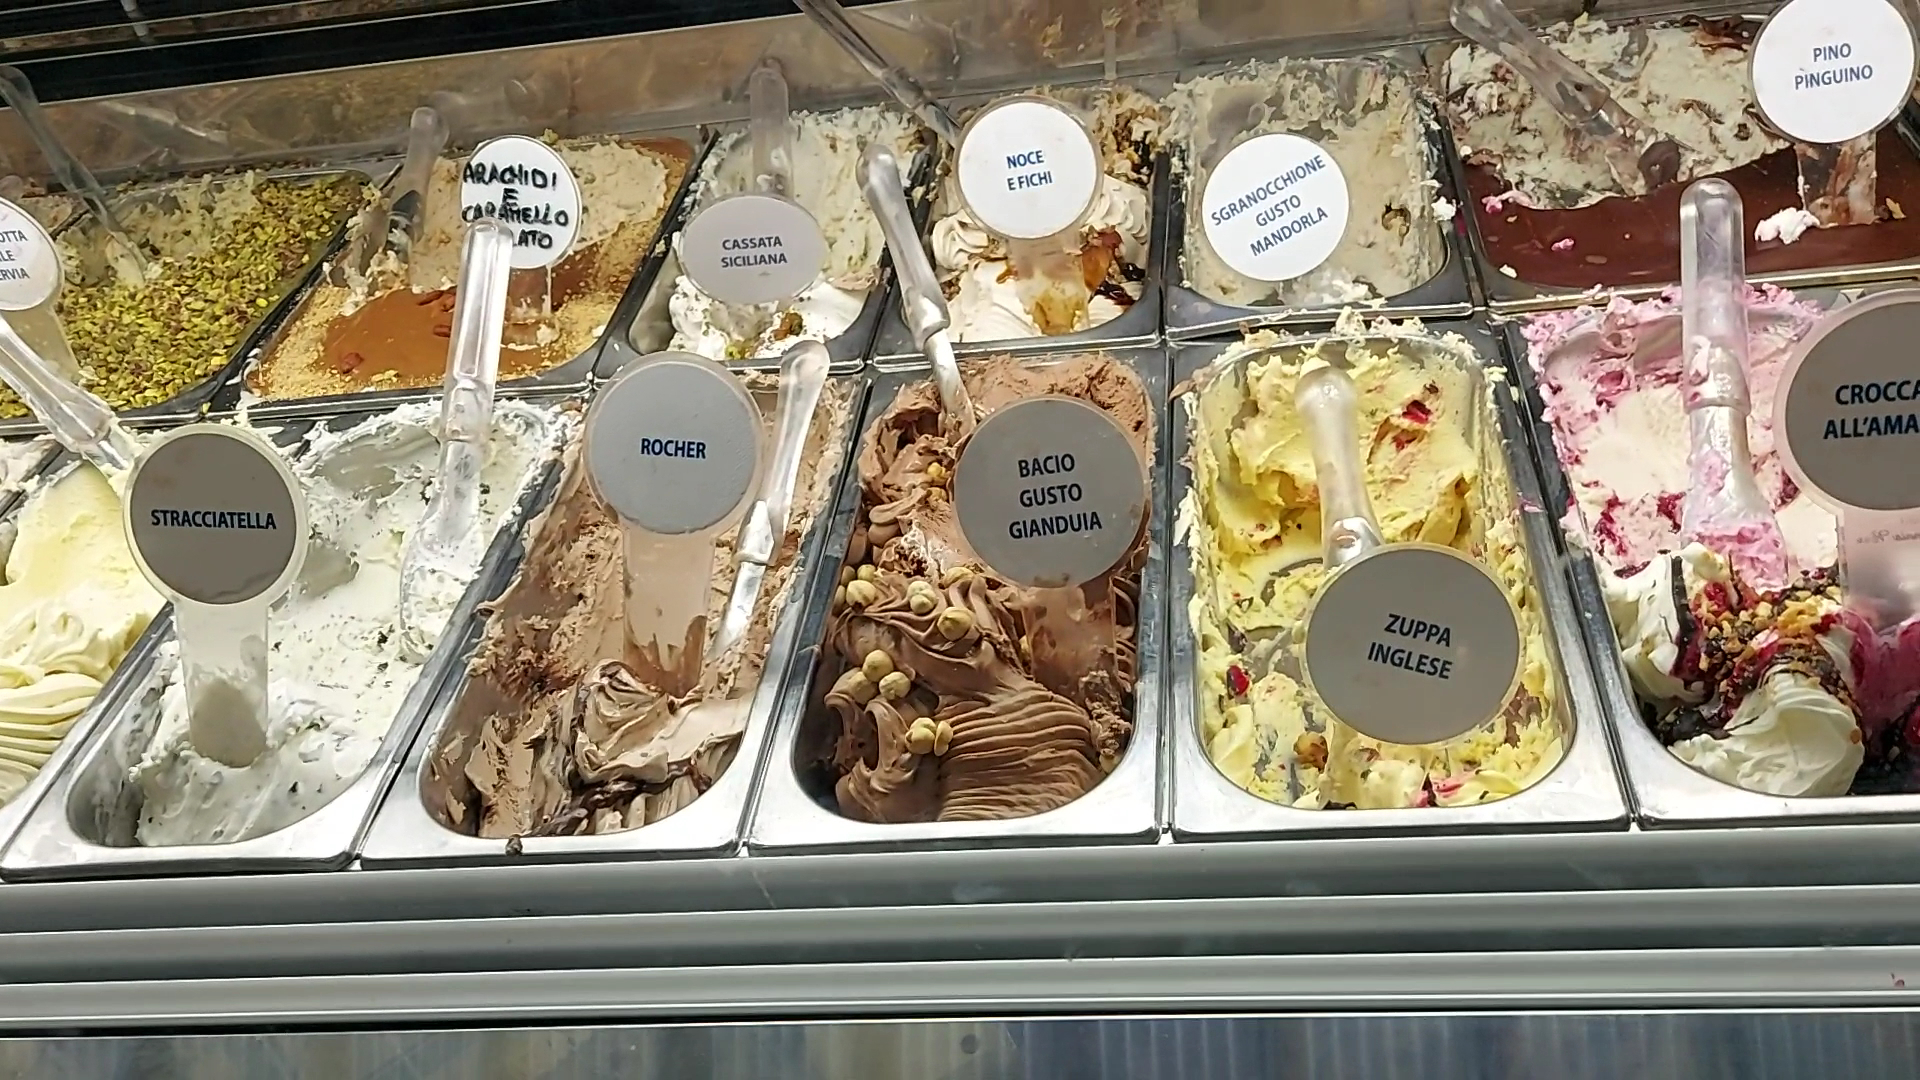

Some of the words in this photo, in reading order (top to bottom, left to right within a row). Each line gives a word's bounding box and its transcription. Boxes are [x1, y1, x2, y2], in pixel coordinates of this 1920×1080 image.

[1813, 42, 1852, 63] PINO
[1794, 64, 1873, 91] PINGUINO
[1006, 150, 1044, 169] NOCE
[463, 161, 557, 190] ARACHIDI
[1007, 177, 1016, 191] E
[1018, 170, 1053, 189] FICHI
[501, 187, 519, 208] E
[1211, 154, 1326, 226] SGRANOCCHIONE
[462, 201, 569, 227] CARAMELLO
[1255, 194, 1301, 227] GUSTO
[722, 236, 783, 250] CASSATA
[1250, 206, 1329, 257] MANDORLA
[721, 253, 788, 268] SICILIANA
[640, 438, 707, 459] ROCHER
[1018, 453, 1075, 478] BACIO
[1019, 483, 1082, 508] GUSTO
[150, 509, 277, 530] STRACCIATELLA
[1008, 511, 1102, 540] GIANDUIA
[1384, 613, 1451, 648] ZUPPA
[1368, 642, 1453, 680] INGLESE
